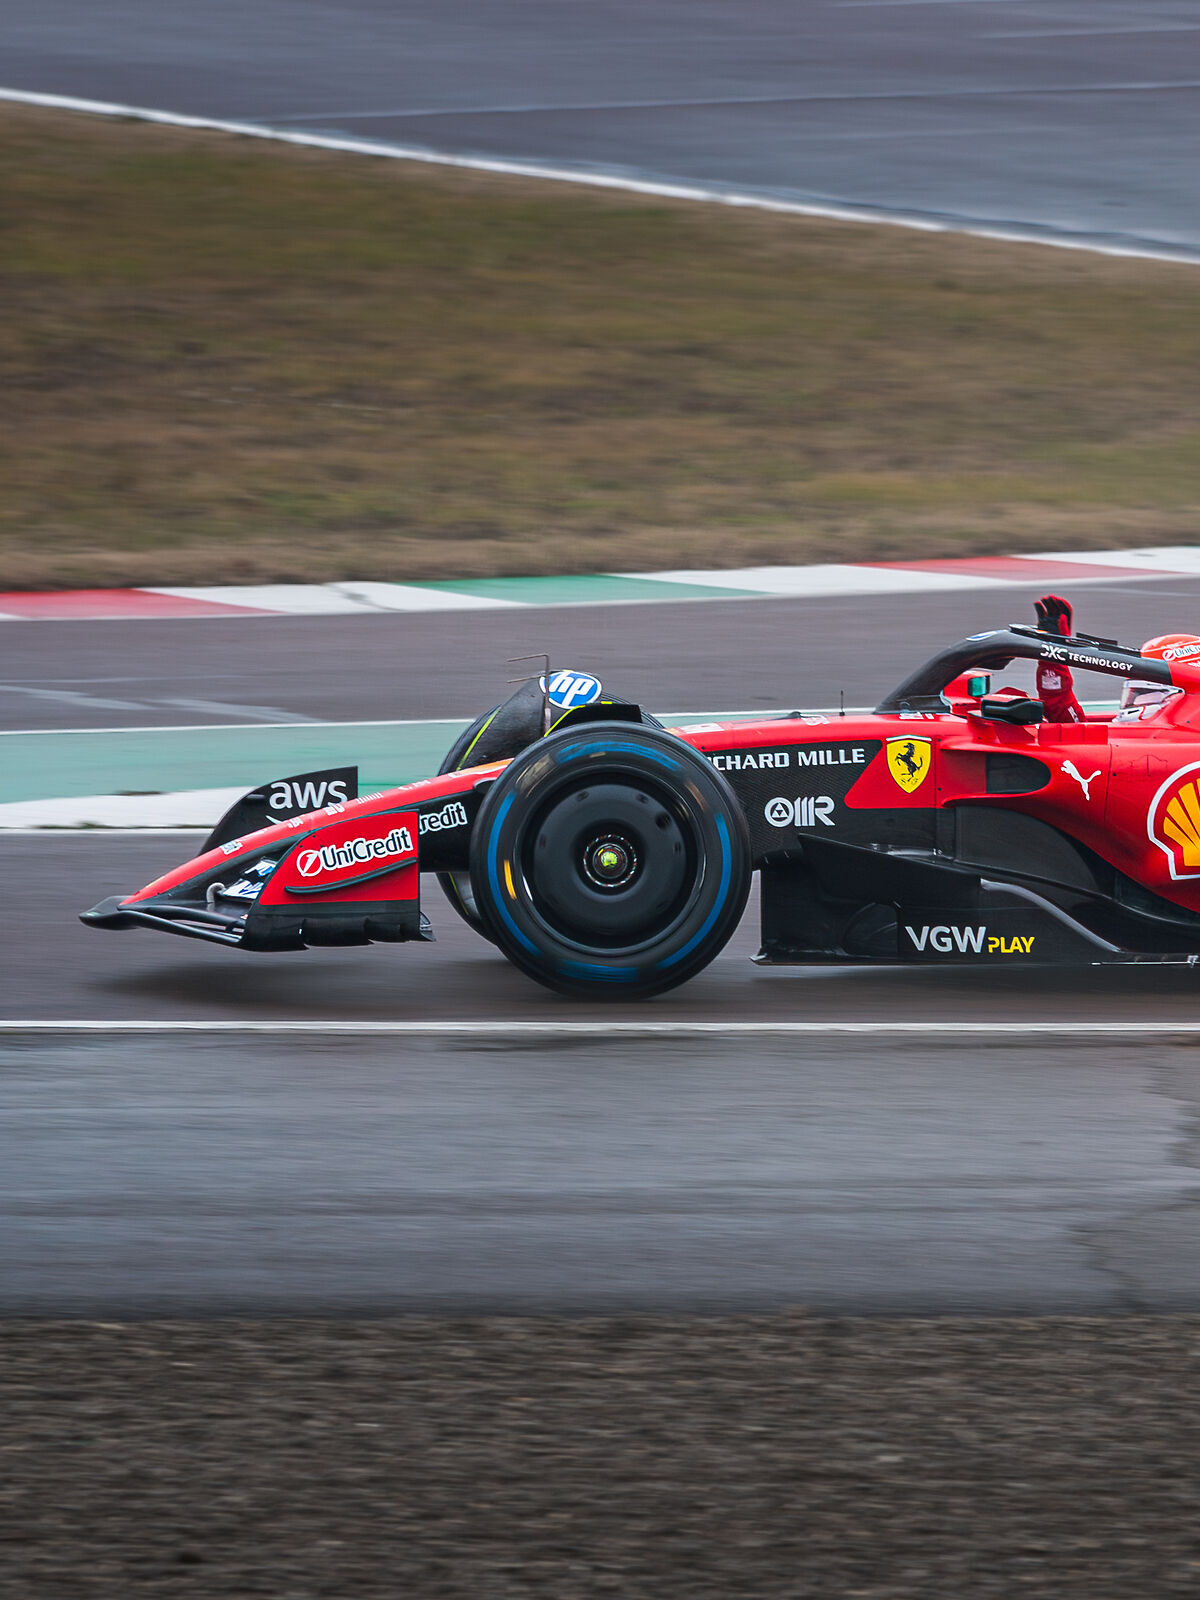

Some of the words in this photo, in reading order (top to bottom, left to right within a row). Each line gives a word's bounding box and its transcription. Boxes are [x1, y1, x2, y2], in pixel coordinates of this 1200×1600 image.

[1068, 652, 1133, 671] TECHNOLOGY
[548, 671, 596, 706] hp
[707, 753, 790, 771] CHARD
[798, 748, 866, 767] MILLE
[269, 780, 348, 810] aws
[420, 803, 467, 833] redit
[321, 828, 412, 868] UniCredit
[905, 926, 987, 953] VGW
[987, 936, 1036, 954] PLAY
